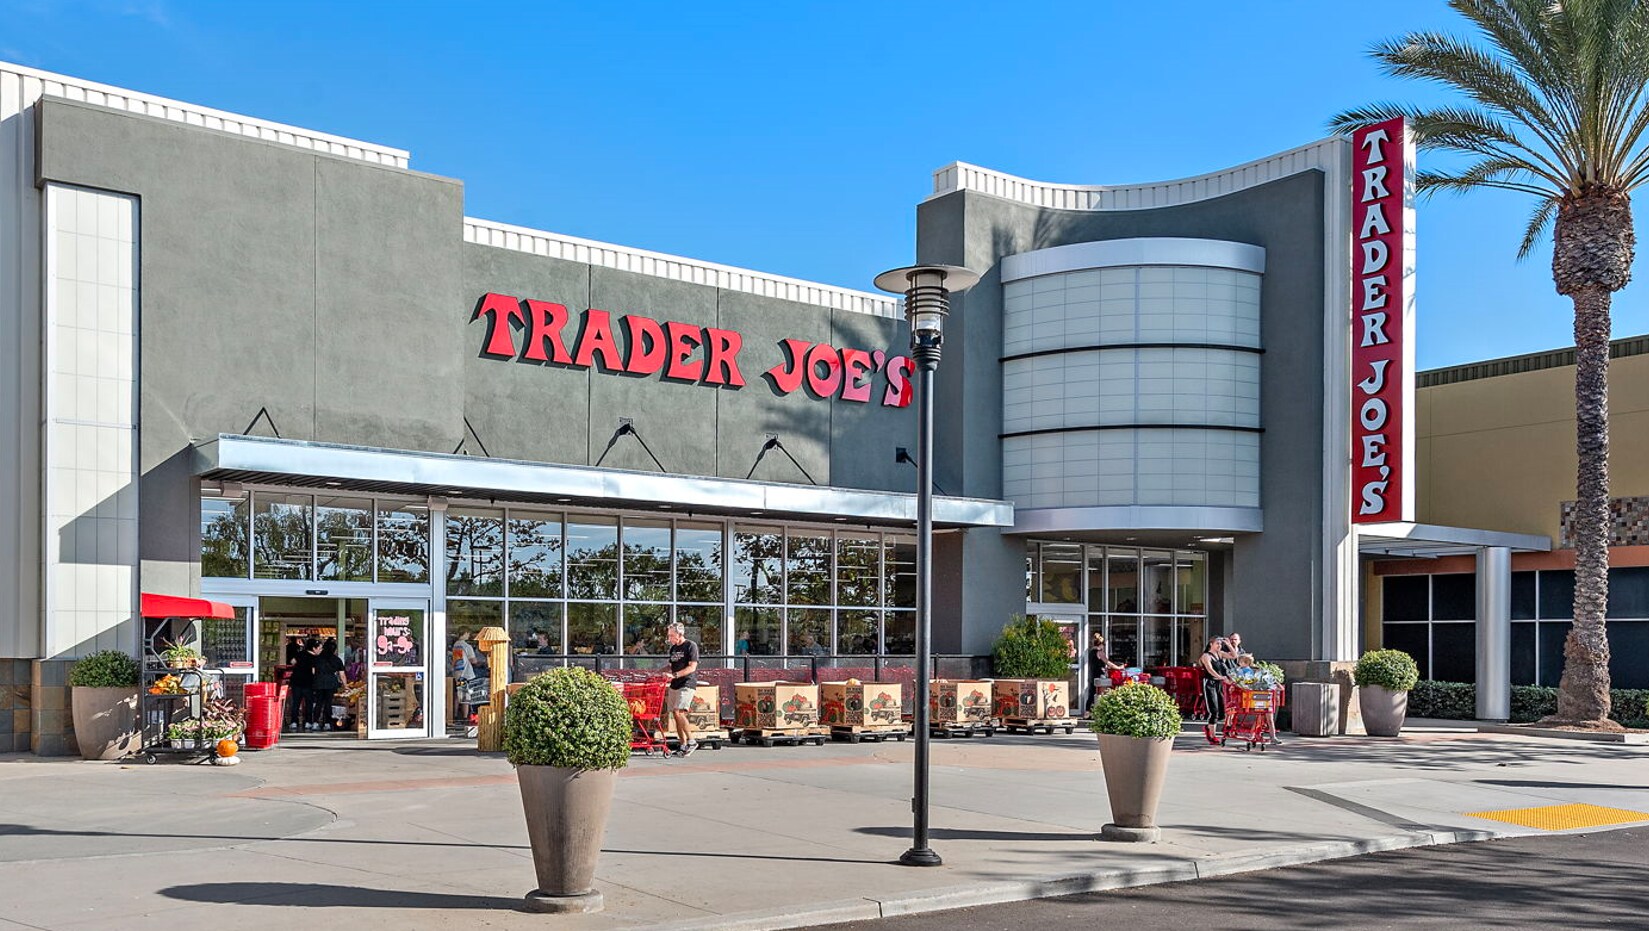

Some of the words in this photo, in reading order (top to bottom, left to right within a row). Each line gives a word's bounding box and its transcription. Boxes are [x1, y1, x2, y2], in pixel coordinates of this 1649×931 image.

[1359, 129, 1391, 348] TRADER
[471, 292, 747, 390] TRADER
[762, 338, 917, 408] JOE'S
[1357, 359, 1391, 516] JOE'S
